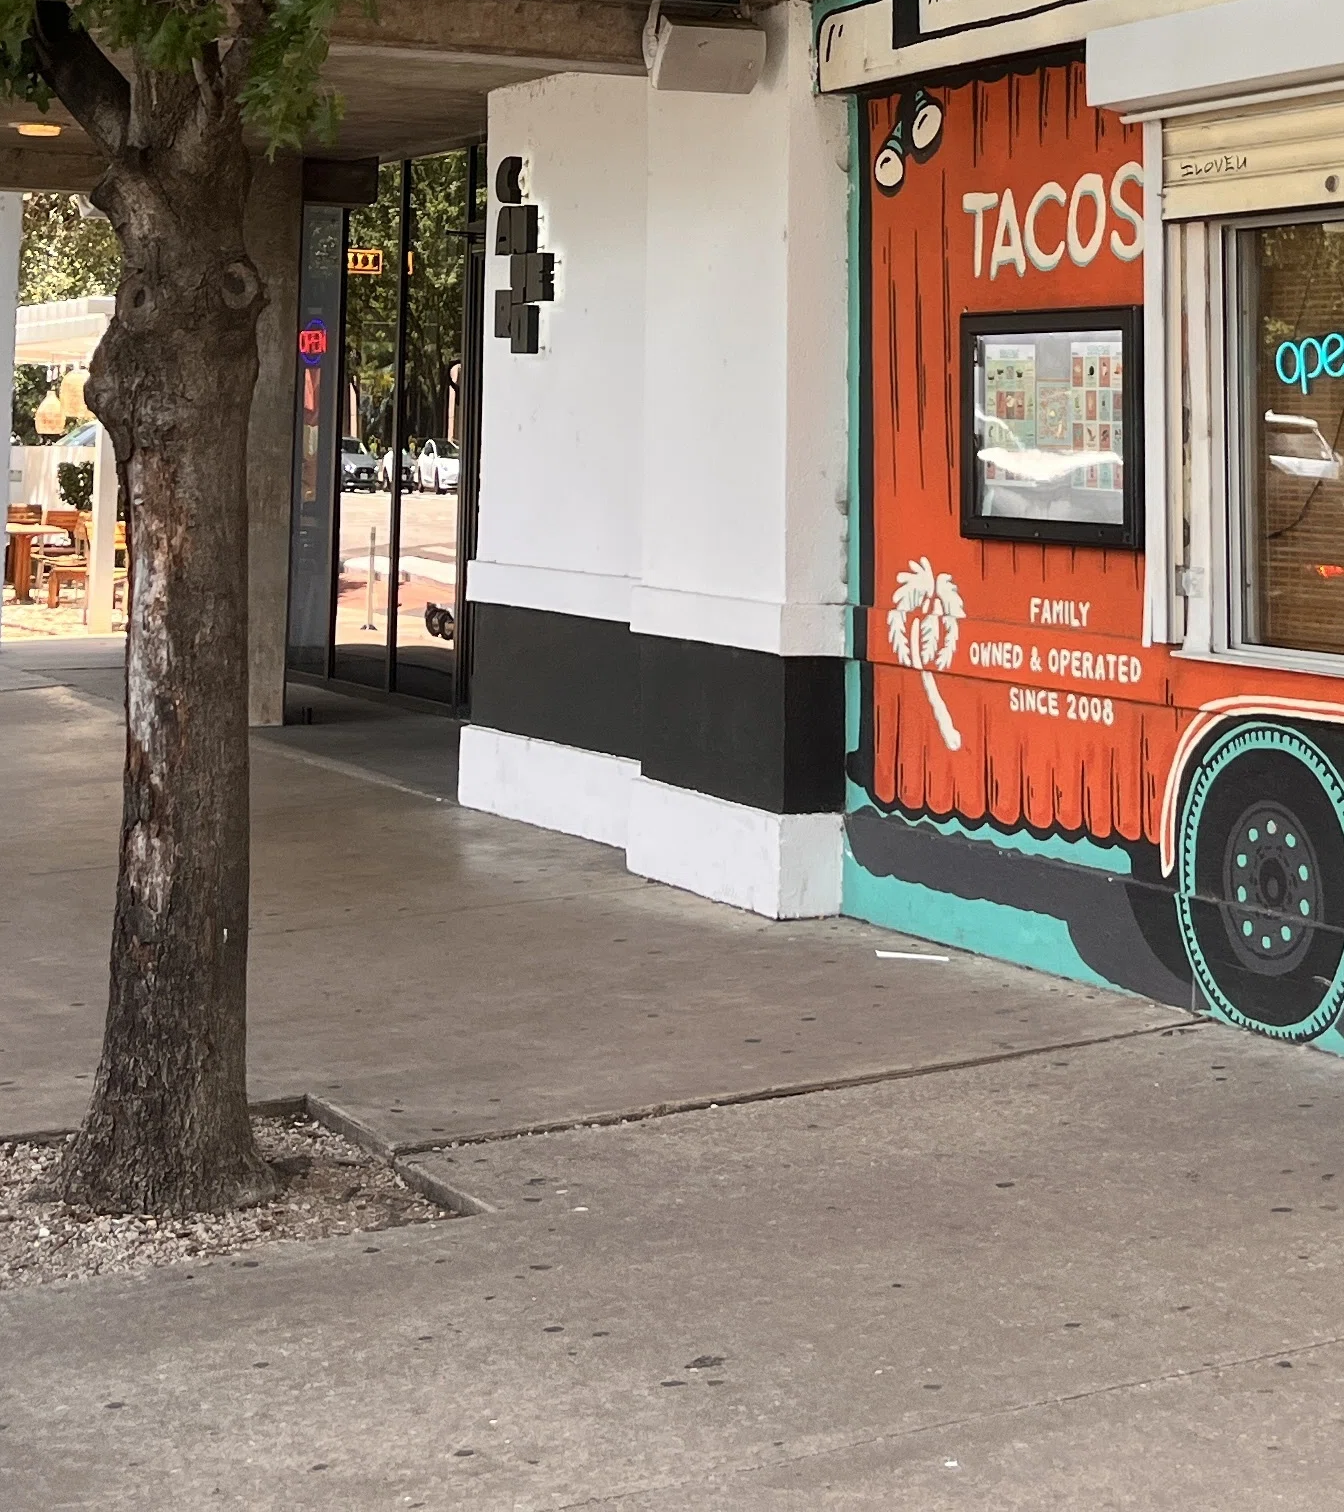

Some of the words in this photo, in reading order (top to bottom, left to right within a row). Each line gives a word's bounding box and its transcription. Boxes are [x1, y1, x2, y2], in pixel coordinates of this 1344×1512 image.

[962, 161, 1145, 281] TACOS
[1029, 597, 1091, 628] FAMILY
[969, 641, 1024, 670] OWNED
[1030, 646, 1043, 673] &
[1047, 648, 1143, 683] OPERATED
[1009, 686, 1060, 717] SINCE
[1066, 693, 1115, 727] 2008
